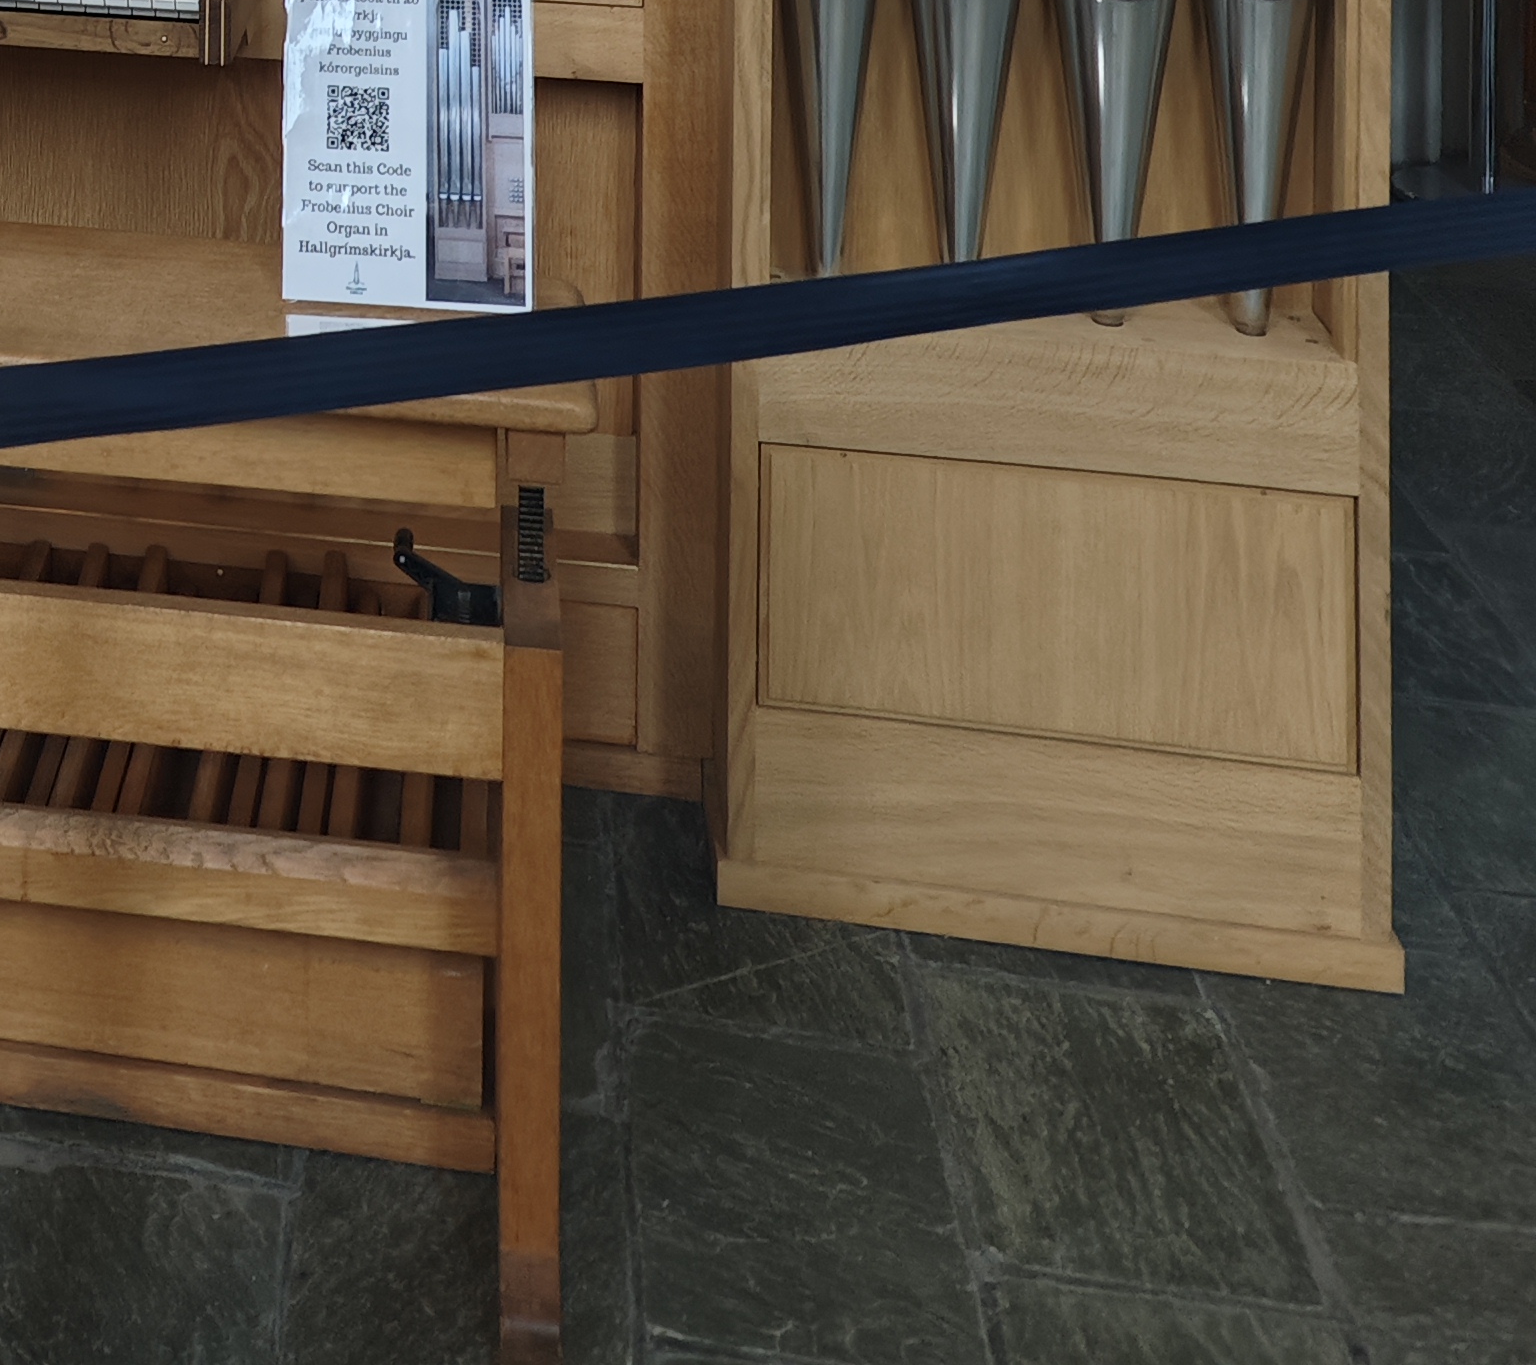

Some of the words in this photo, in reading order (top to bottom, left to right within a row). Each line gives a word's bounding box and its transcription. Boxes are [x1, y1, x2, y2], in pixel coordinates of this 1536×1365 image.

[326, 44, 392, 58] Frobenius
[318, 61, 400, 76] kórorgelsins
[308, 158, 343, 173] Scan
[346, 161, 374, 174] this
[376, 162, 412, 176] Code
[308, 180, 323, 192] to
[384, 184, 407, 196] the
[300, 199, 372, 215] Frobenius
[375, 203, 415, 218] Choir
[326, 221, 370, 238] Organ
[374, 223, 388, 236] in
